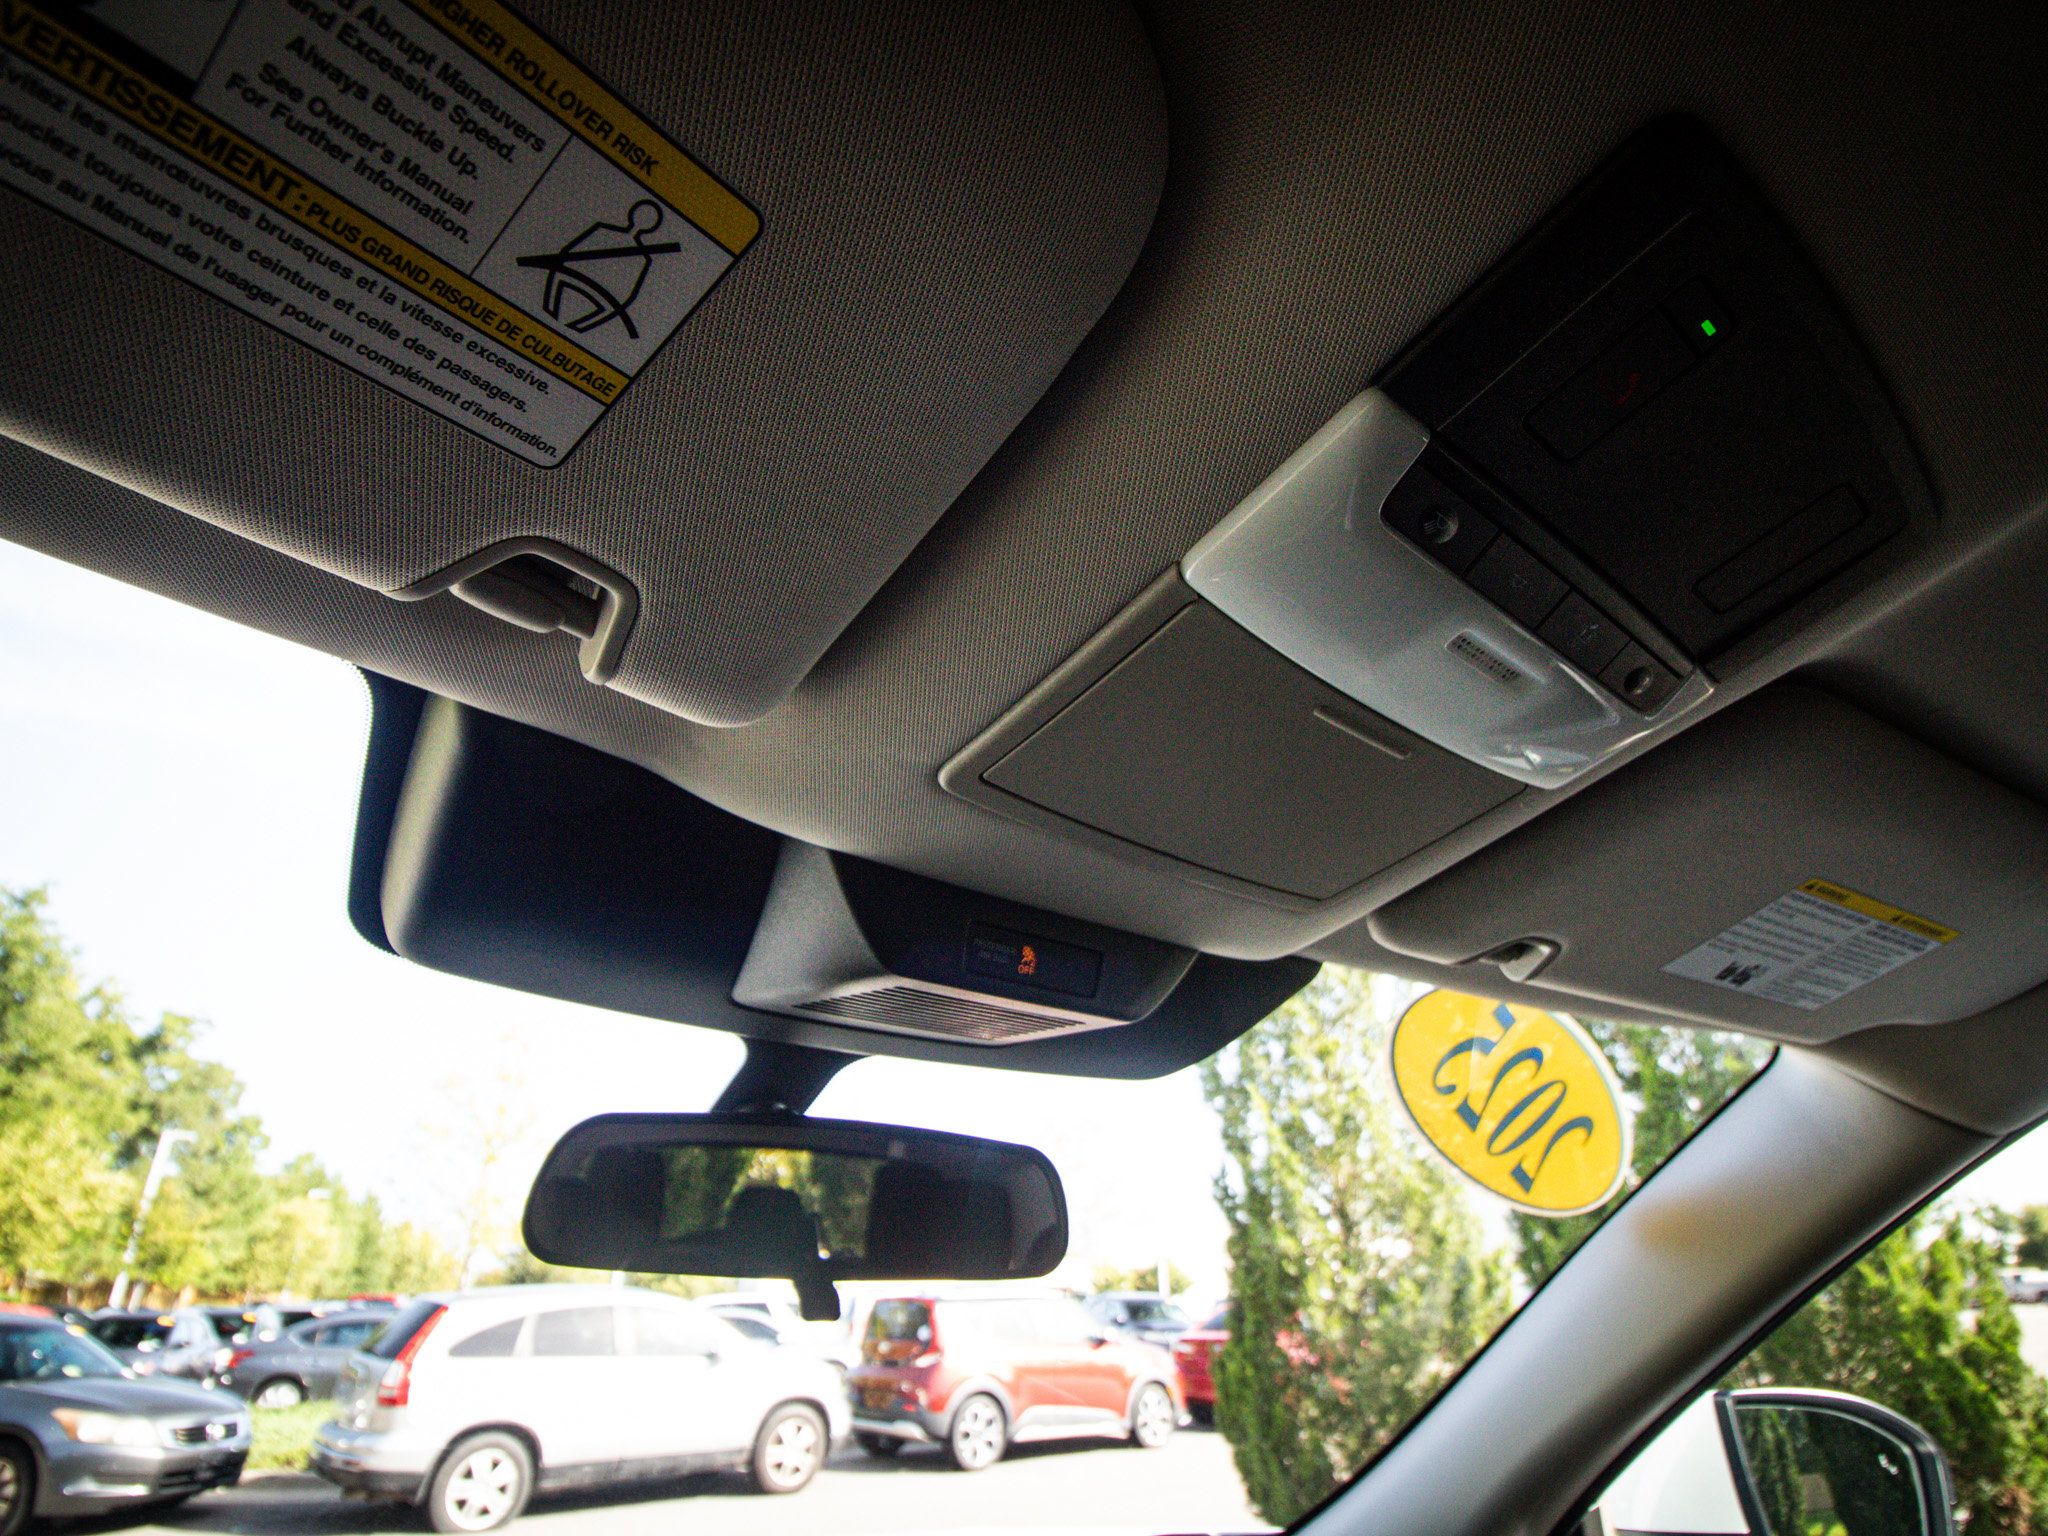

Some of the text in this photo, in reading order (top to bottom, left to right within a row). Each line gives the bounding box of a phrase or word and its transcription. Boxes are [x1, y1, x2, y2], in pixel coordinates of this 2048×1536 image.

[258, 62, 475, 215] See Owner's Manual
[286, 36, 478, 180] Always Buckle Up.
[337, 22, 446, 111] Excessive
[448, 104, 514, 163] Speed.
[357, 5, 547, 152] Abrupt Maneuvers
[505, 47, 615, 142] ROLLOVER
[612, 133, 660, 177] RISK
[225, 72, 470, 244] For Further Information.
[57, 179, 87, 202] au
[91, 194, 175, 249] Manuel
[172, 240, 200, 265] de
[201, 254, 281, 305] l'usager
[280, 303, 328, 333] pour
[328, 328, 355, 349] un
[355, 343, 461, 407] complément
[460, 396, 558, 460] d'information.
[70, 102, 108, 137] les
[113, 131, 251, 220] manœuvres
[255, 214, 354, 282] brusques
[355, 273, 379, 295] et
[379, 285, 398, 306] la
[400, 298, 465, 344] vitesse
[465, 339, 551, 396] excessive.
[83, 152, 183, 219] toujours
[187, 211, 244, 252] votre
[246, 247, 331, 303] ceinture
[333, 293, 355, 314] et
[355, 308, 400, 341] celle
[402, 334, 436, 363] des
[439, 355, 529, 414] passagers.
[305, 203, 361, 244] PLUS
[361, 235, 434, 286] GRAND
[432, 278, 495, 327] RISQUE
[496, 316, 520, 340] DE
[520, 334, 617, 397] CULBUTAGE
[1018, 965, 1035, 975] OFF
